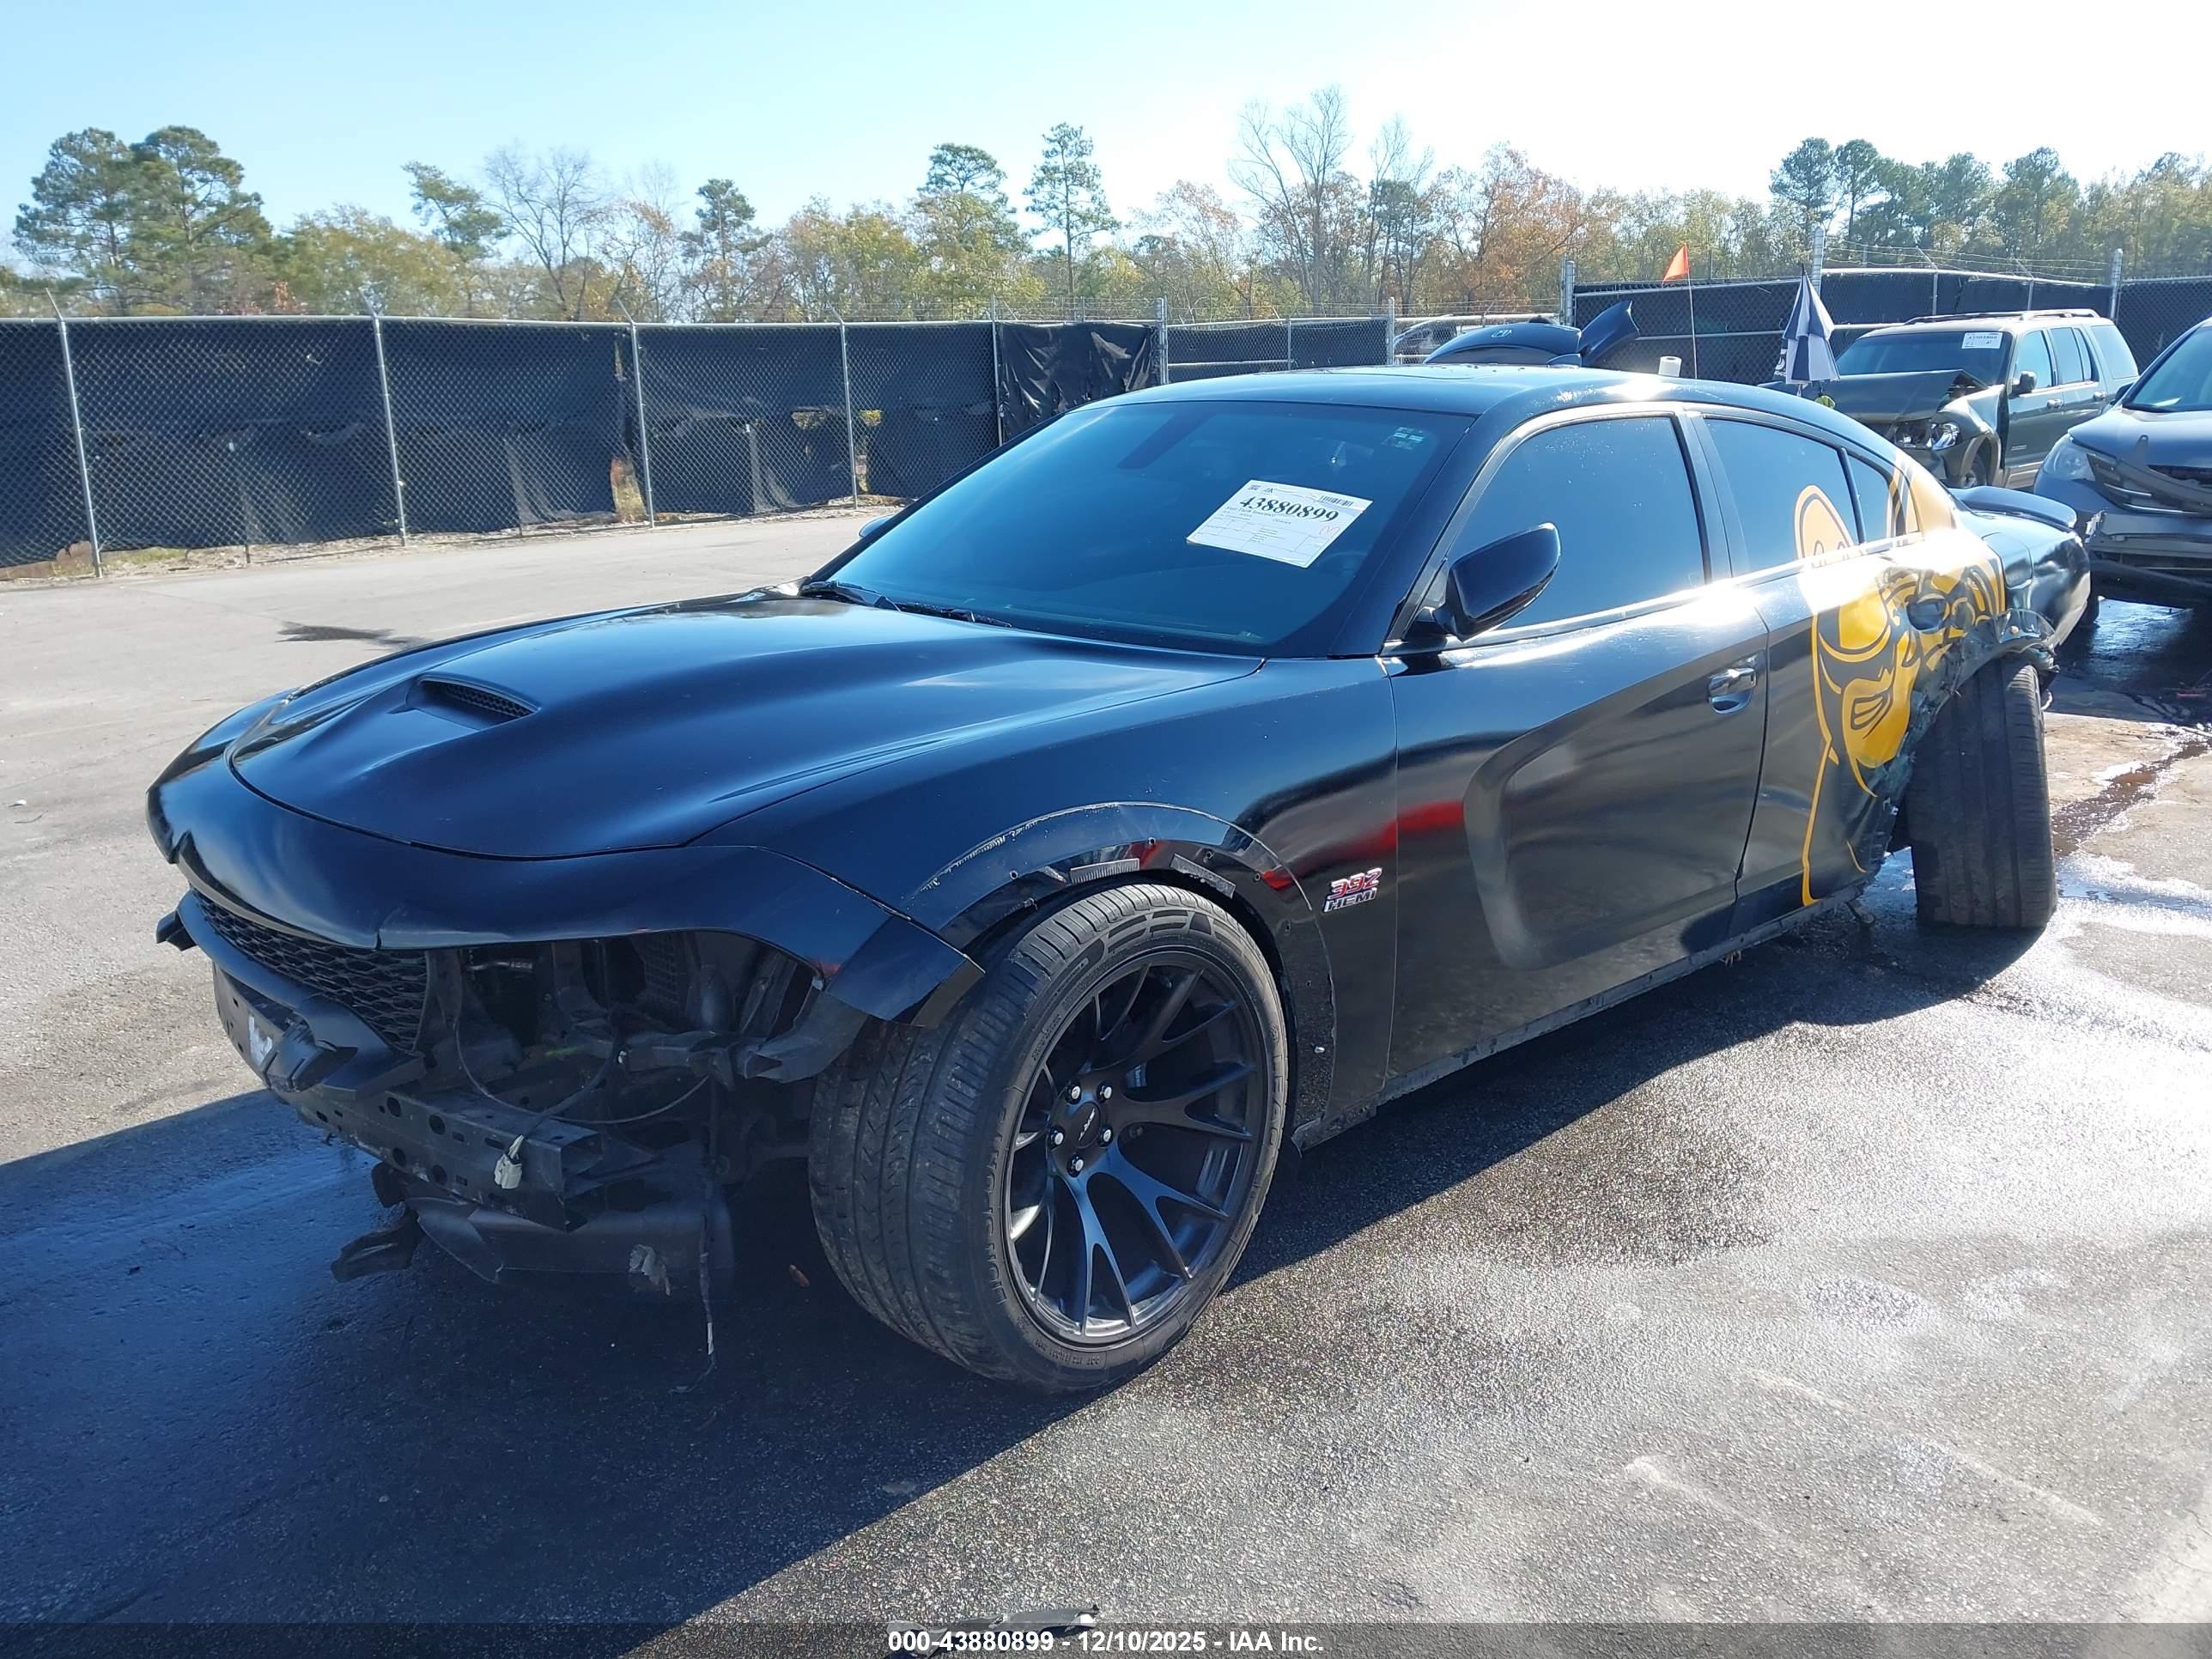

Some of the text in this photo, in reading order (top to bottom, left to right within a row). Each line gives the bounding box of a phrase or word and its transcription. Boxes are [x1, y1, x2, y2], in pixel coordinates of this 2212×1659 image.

[1239, 496, 1339, 522] 43880899
[1329, 867, 1382, 899] 392
[1322, 887, 1377, 913] HEMI
